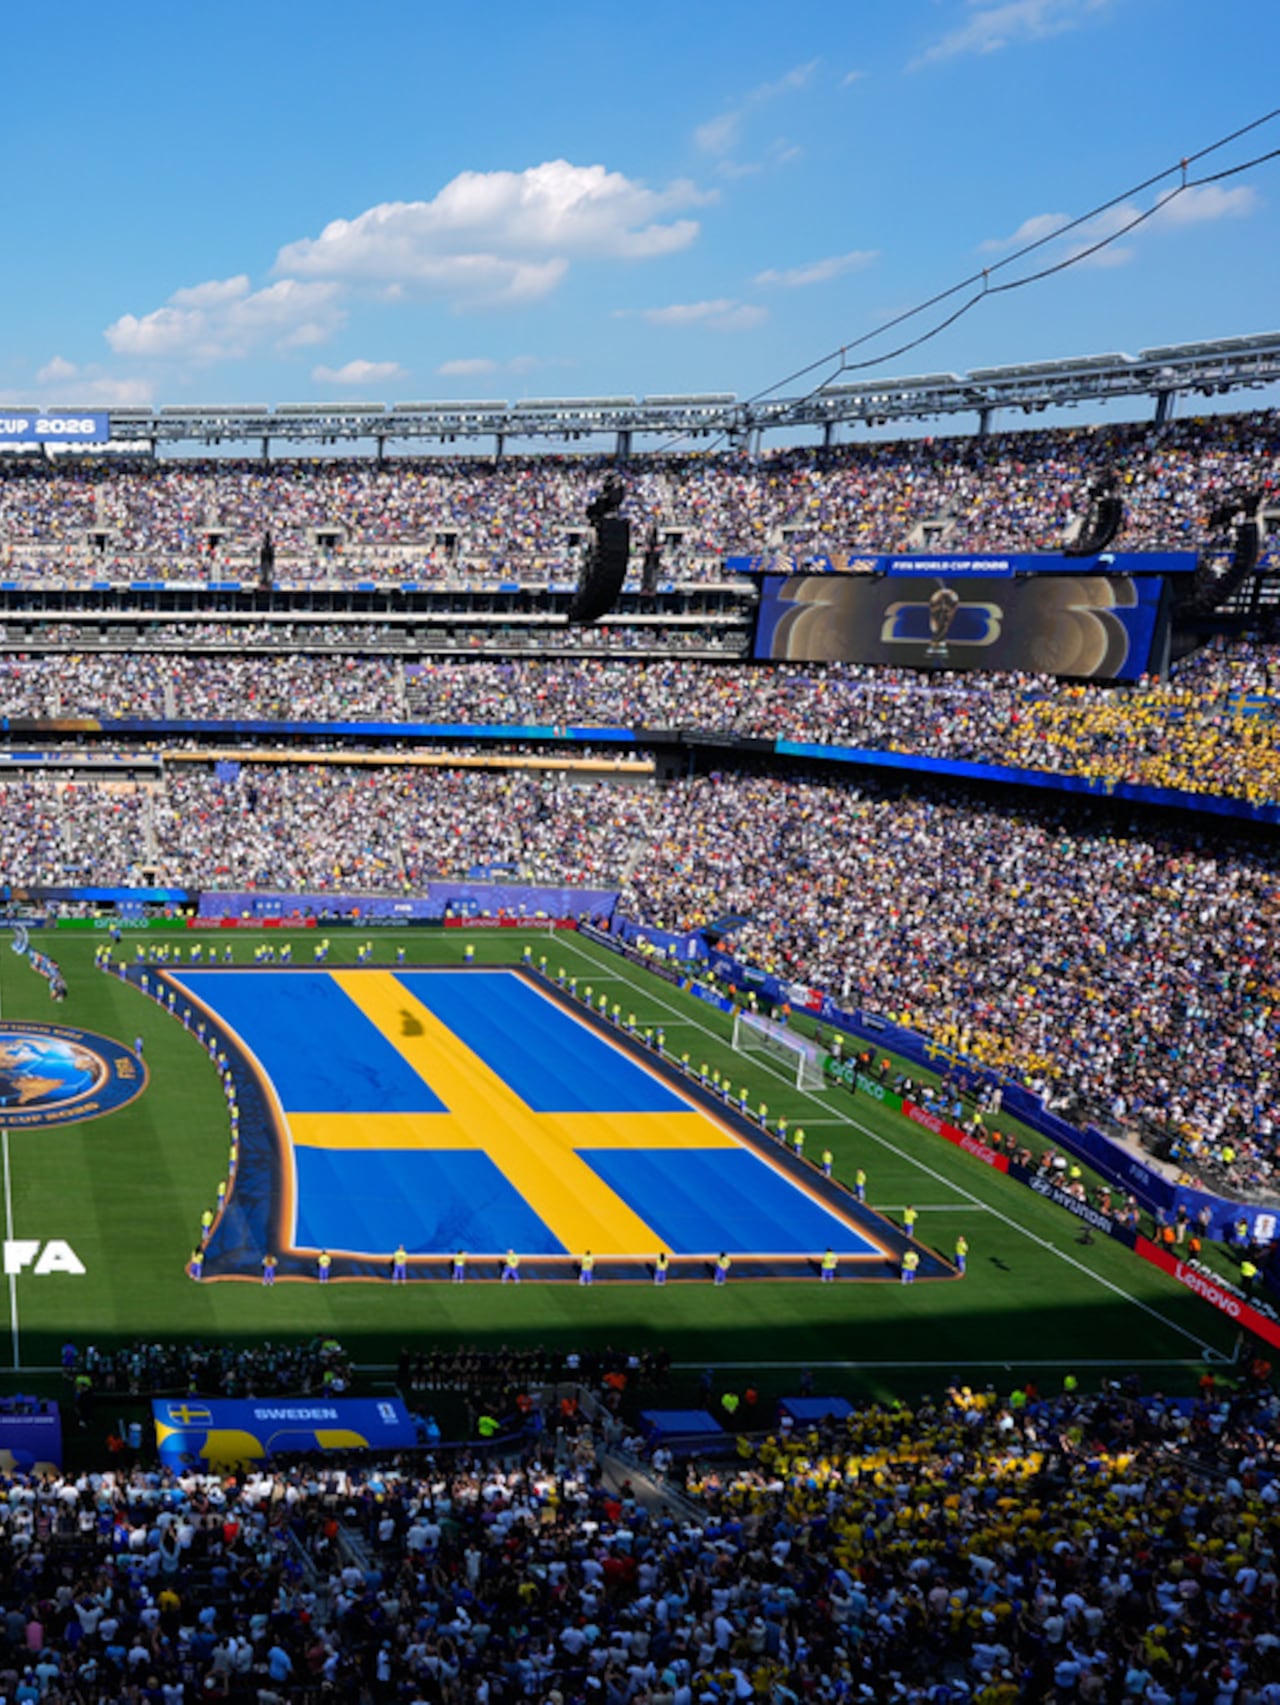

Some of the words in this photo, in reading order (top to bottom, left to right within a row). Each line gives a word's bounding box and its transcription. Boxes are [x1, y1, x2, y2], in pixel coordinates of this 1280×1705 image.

[34, 418, 96, 434] 2026
[94, 917, 149, 929] aramco
[462, 918, 501, 928] Lenovo
[1052, 1189, 1113, 1235] HYUNDAI
[1175, 1263, 1241, 1318] Lenovo
[254, 1407, 339, 1420] SWEDEN
